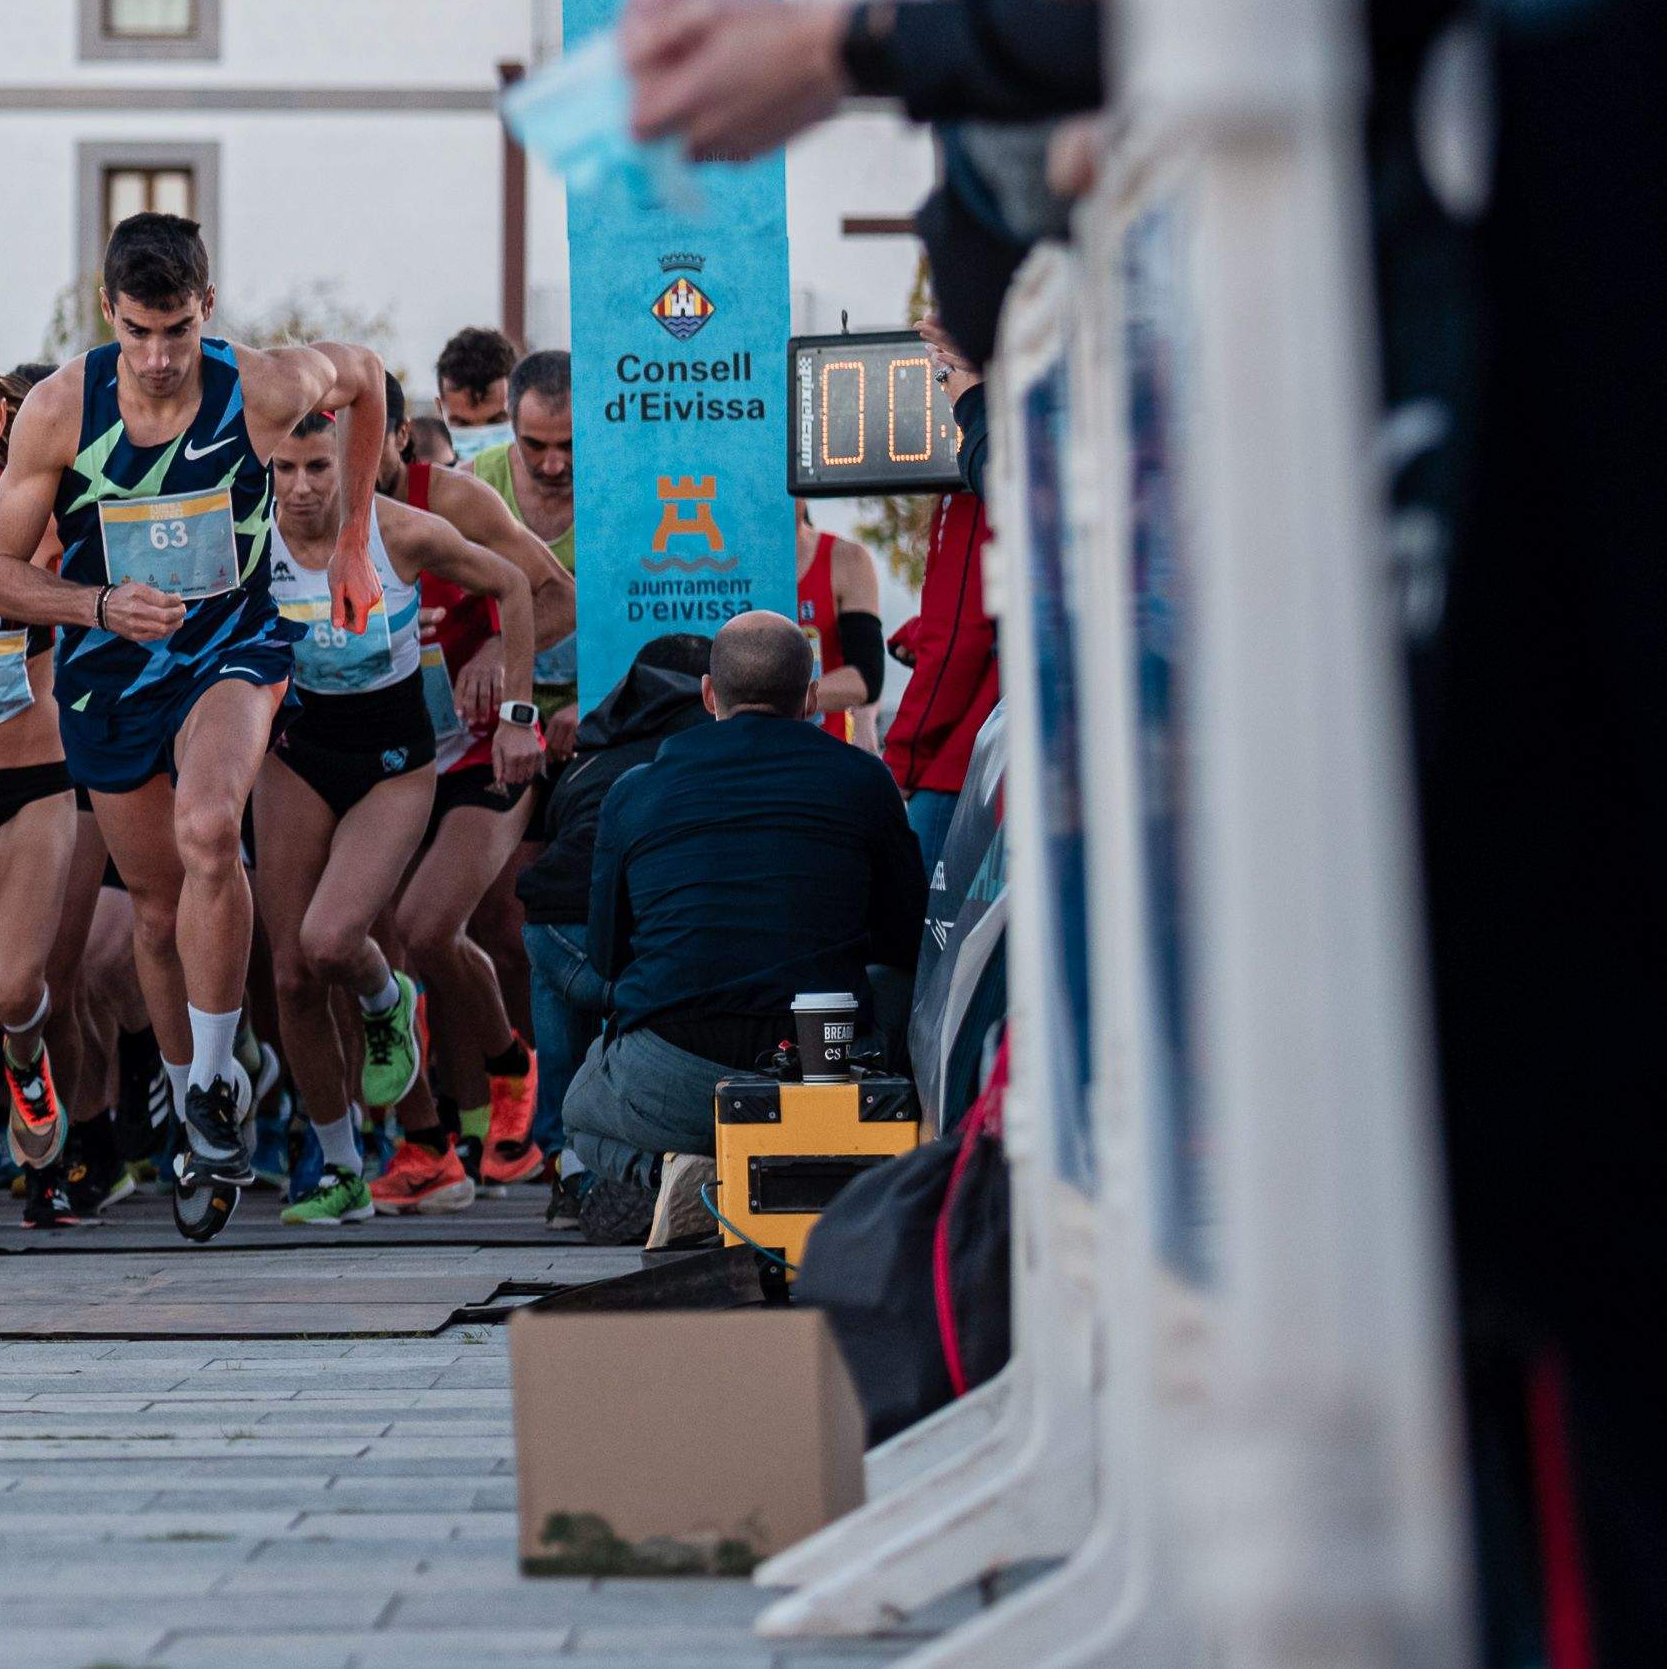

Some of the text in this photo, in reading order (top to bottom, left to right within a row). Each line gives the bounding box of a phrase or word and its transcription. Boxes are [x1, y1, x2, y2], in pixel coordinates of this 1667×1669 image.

[616, 351, 752, 384] Consell
[604, 392, 766, 423] d'Eivissa
[150, 520, 188, 550] 63
